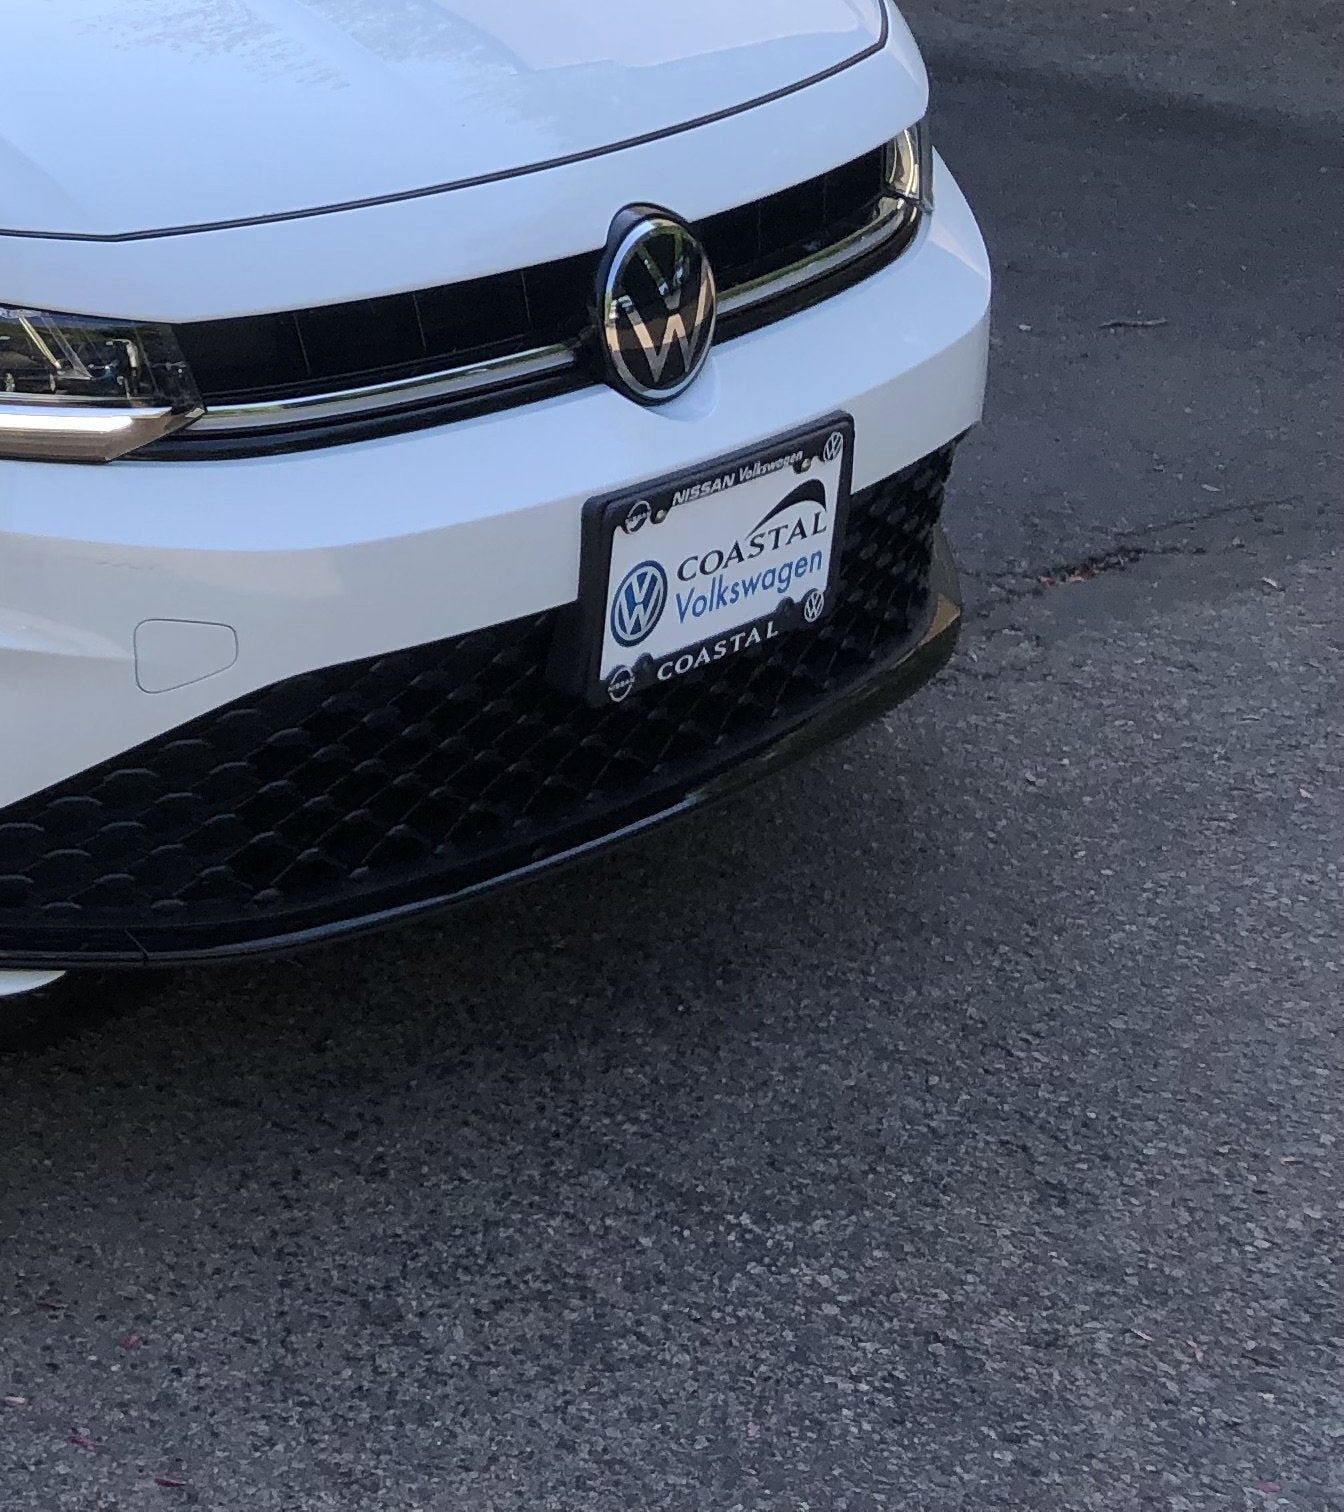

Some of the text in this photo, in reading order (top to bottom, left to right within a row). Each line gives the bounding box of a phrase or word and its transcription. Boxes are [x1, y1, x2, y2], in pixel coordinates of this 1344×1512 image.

[672, 450, 803, 506] NISSAN Volkswagen
[676, 511, 828, 582] COASTAL
[676, 549, 823, 624] Volkswagen
[657, 621, 779, 681] COASTAL
